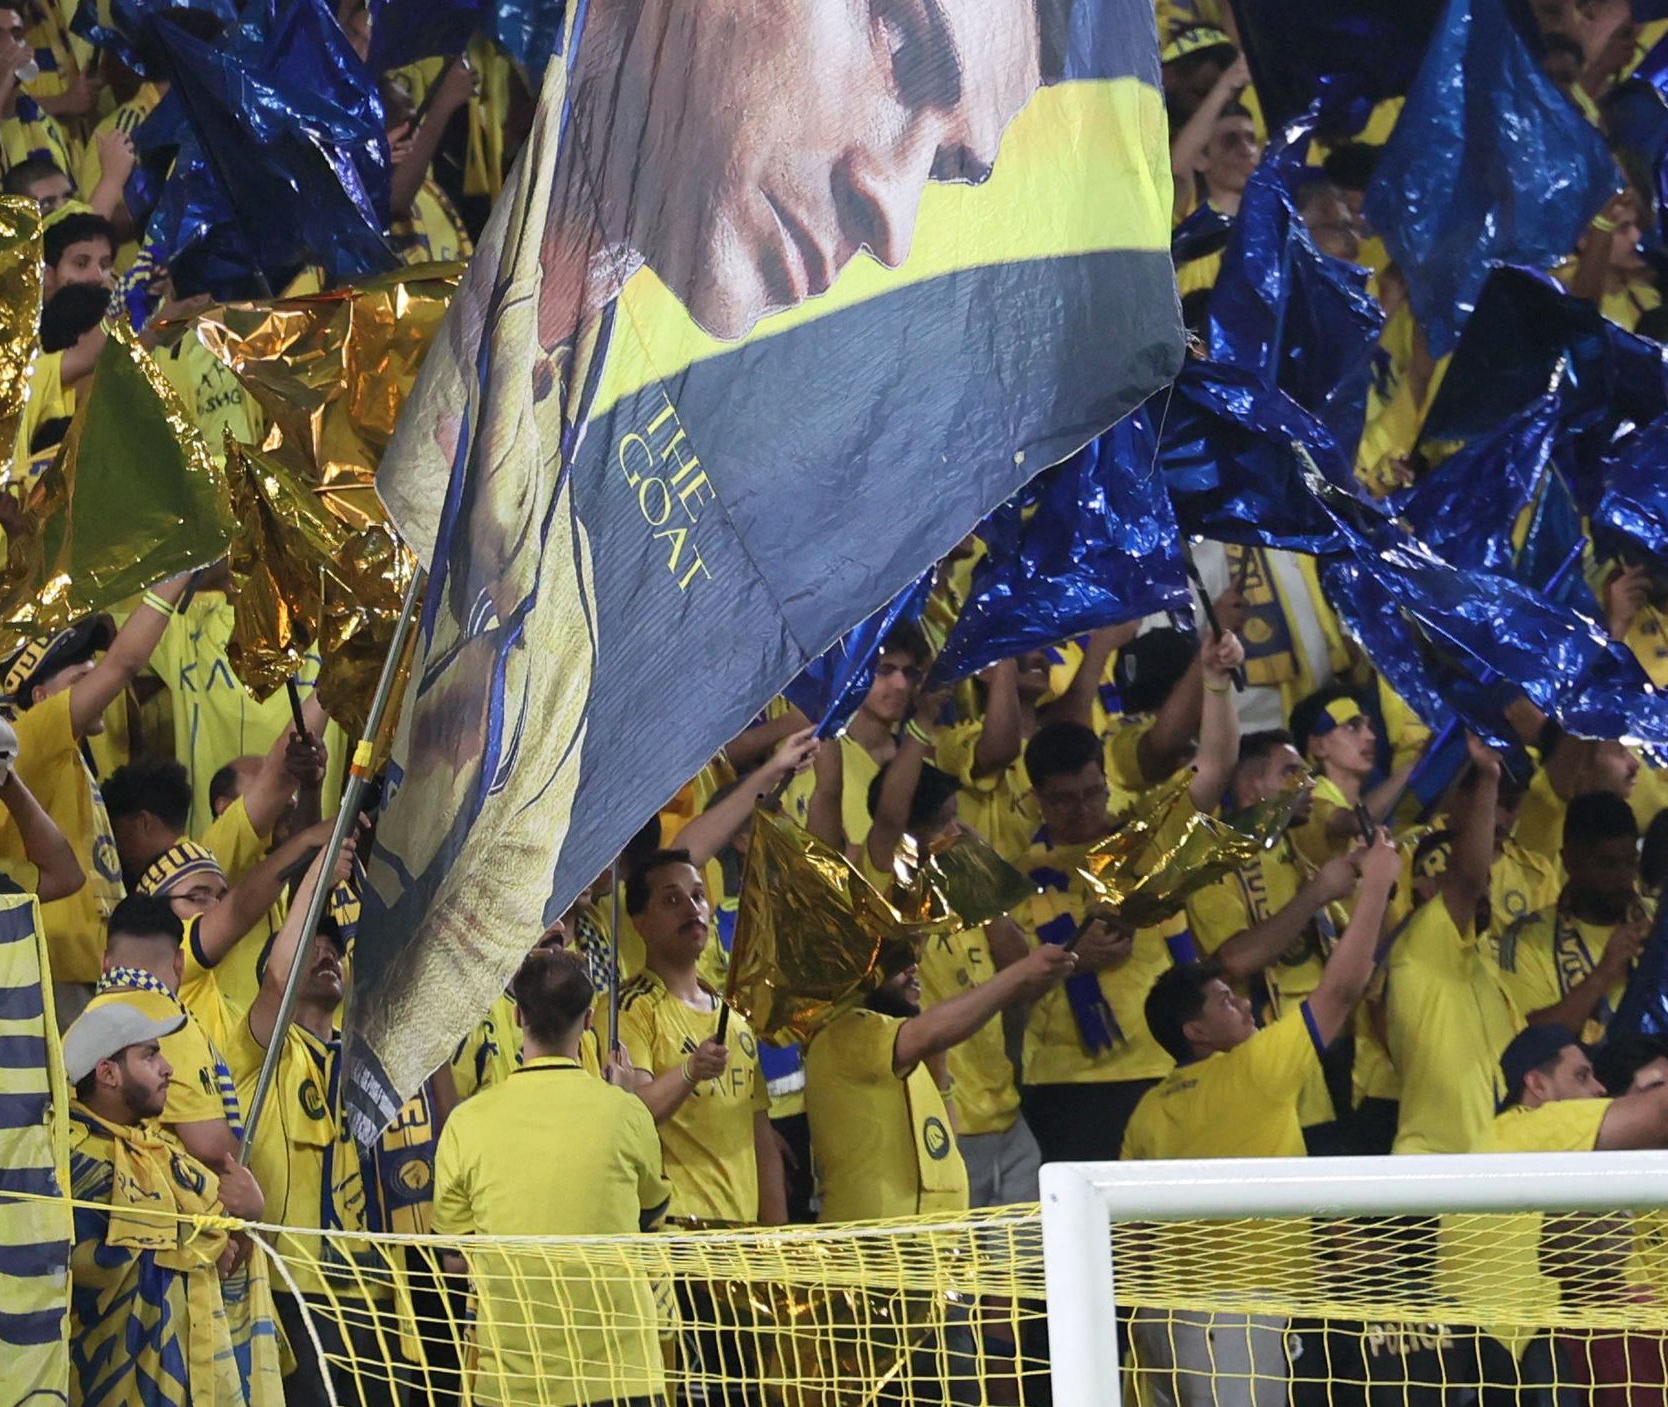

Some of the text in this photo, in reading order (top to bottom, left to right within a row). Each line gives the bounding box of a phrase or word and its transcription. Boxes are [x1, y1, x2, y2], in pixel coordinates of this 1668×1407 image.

[618, 432, 713, 594] GOAT
[645, 391, 717, 525] THE
[1369, 1323, 1454, 1357] POLICE
